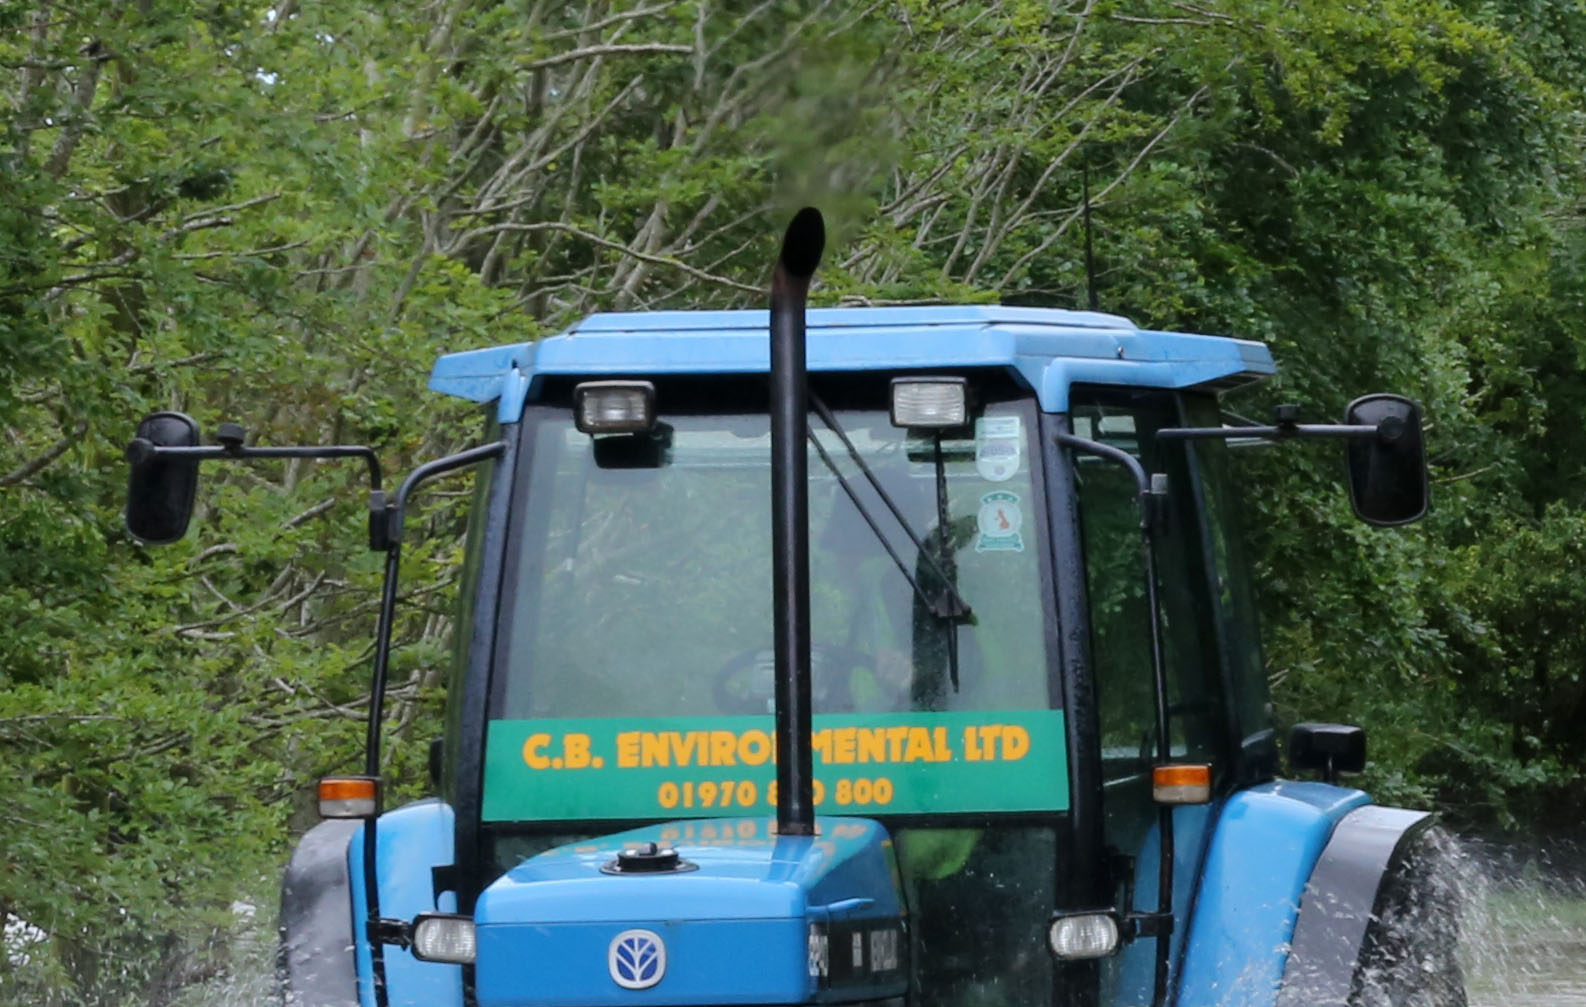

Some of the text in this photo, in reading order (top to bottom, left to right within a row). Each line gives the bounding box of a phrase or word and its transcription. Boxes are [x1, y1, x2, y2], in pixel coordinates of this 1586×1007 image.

[522, 724, 1030, 770] C.B. ENVIROMENTAL LTD
[658, 777, 893, 809] 01970 80 800
